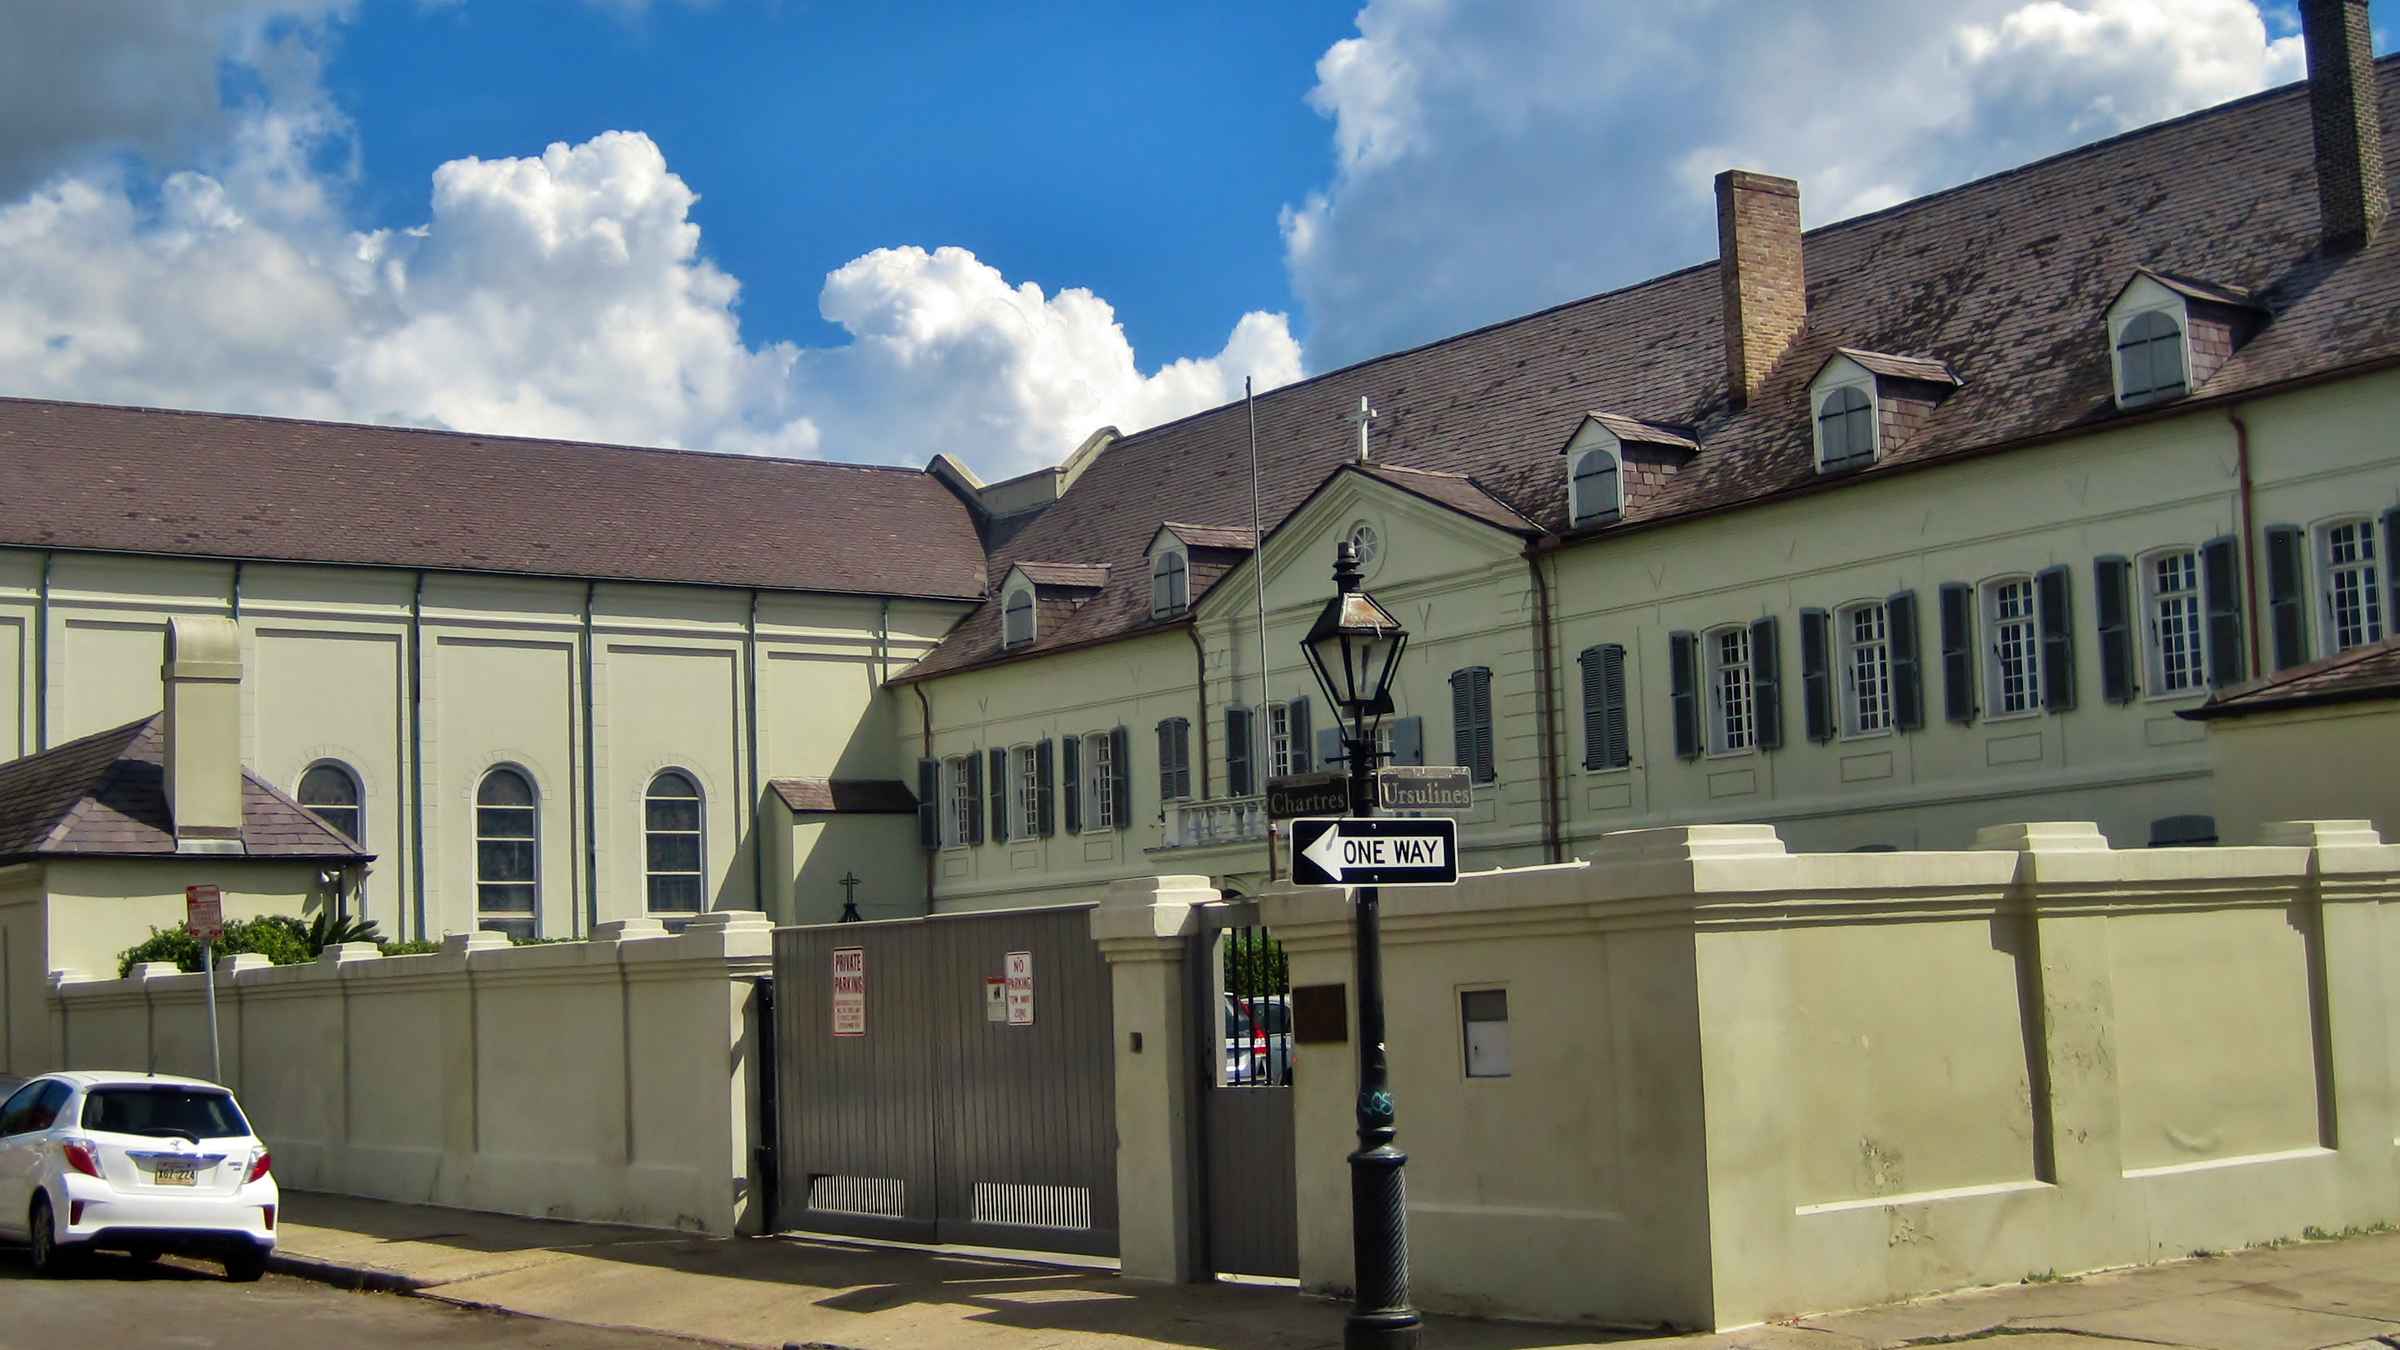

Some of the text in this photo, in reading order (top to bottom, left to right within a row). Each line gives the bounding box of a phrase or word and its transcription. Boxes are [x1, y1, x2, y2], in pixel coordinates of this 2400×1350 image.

[1381, 782, 1470, 804] Ursulines
[1271, 792, 1345, 815] Chartres
[1344, 840, 1437, 865] ONE WAY
[835, 953, 861, 972] PRIVATE
[1013, 959, 1024, 973] NO
[834, 976, 863, 993] PARKING
